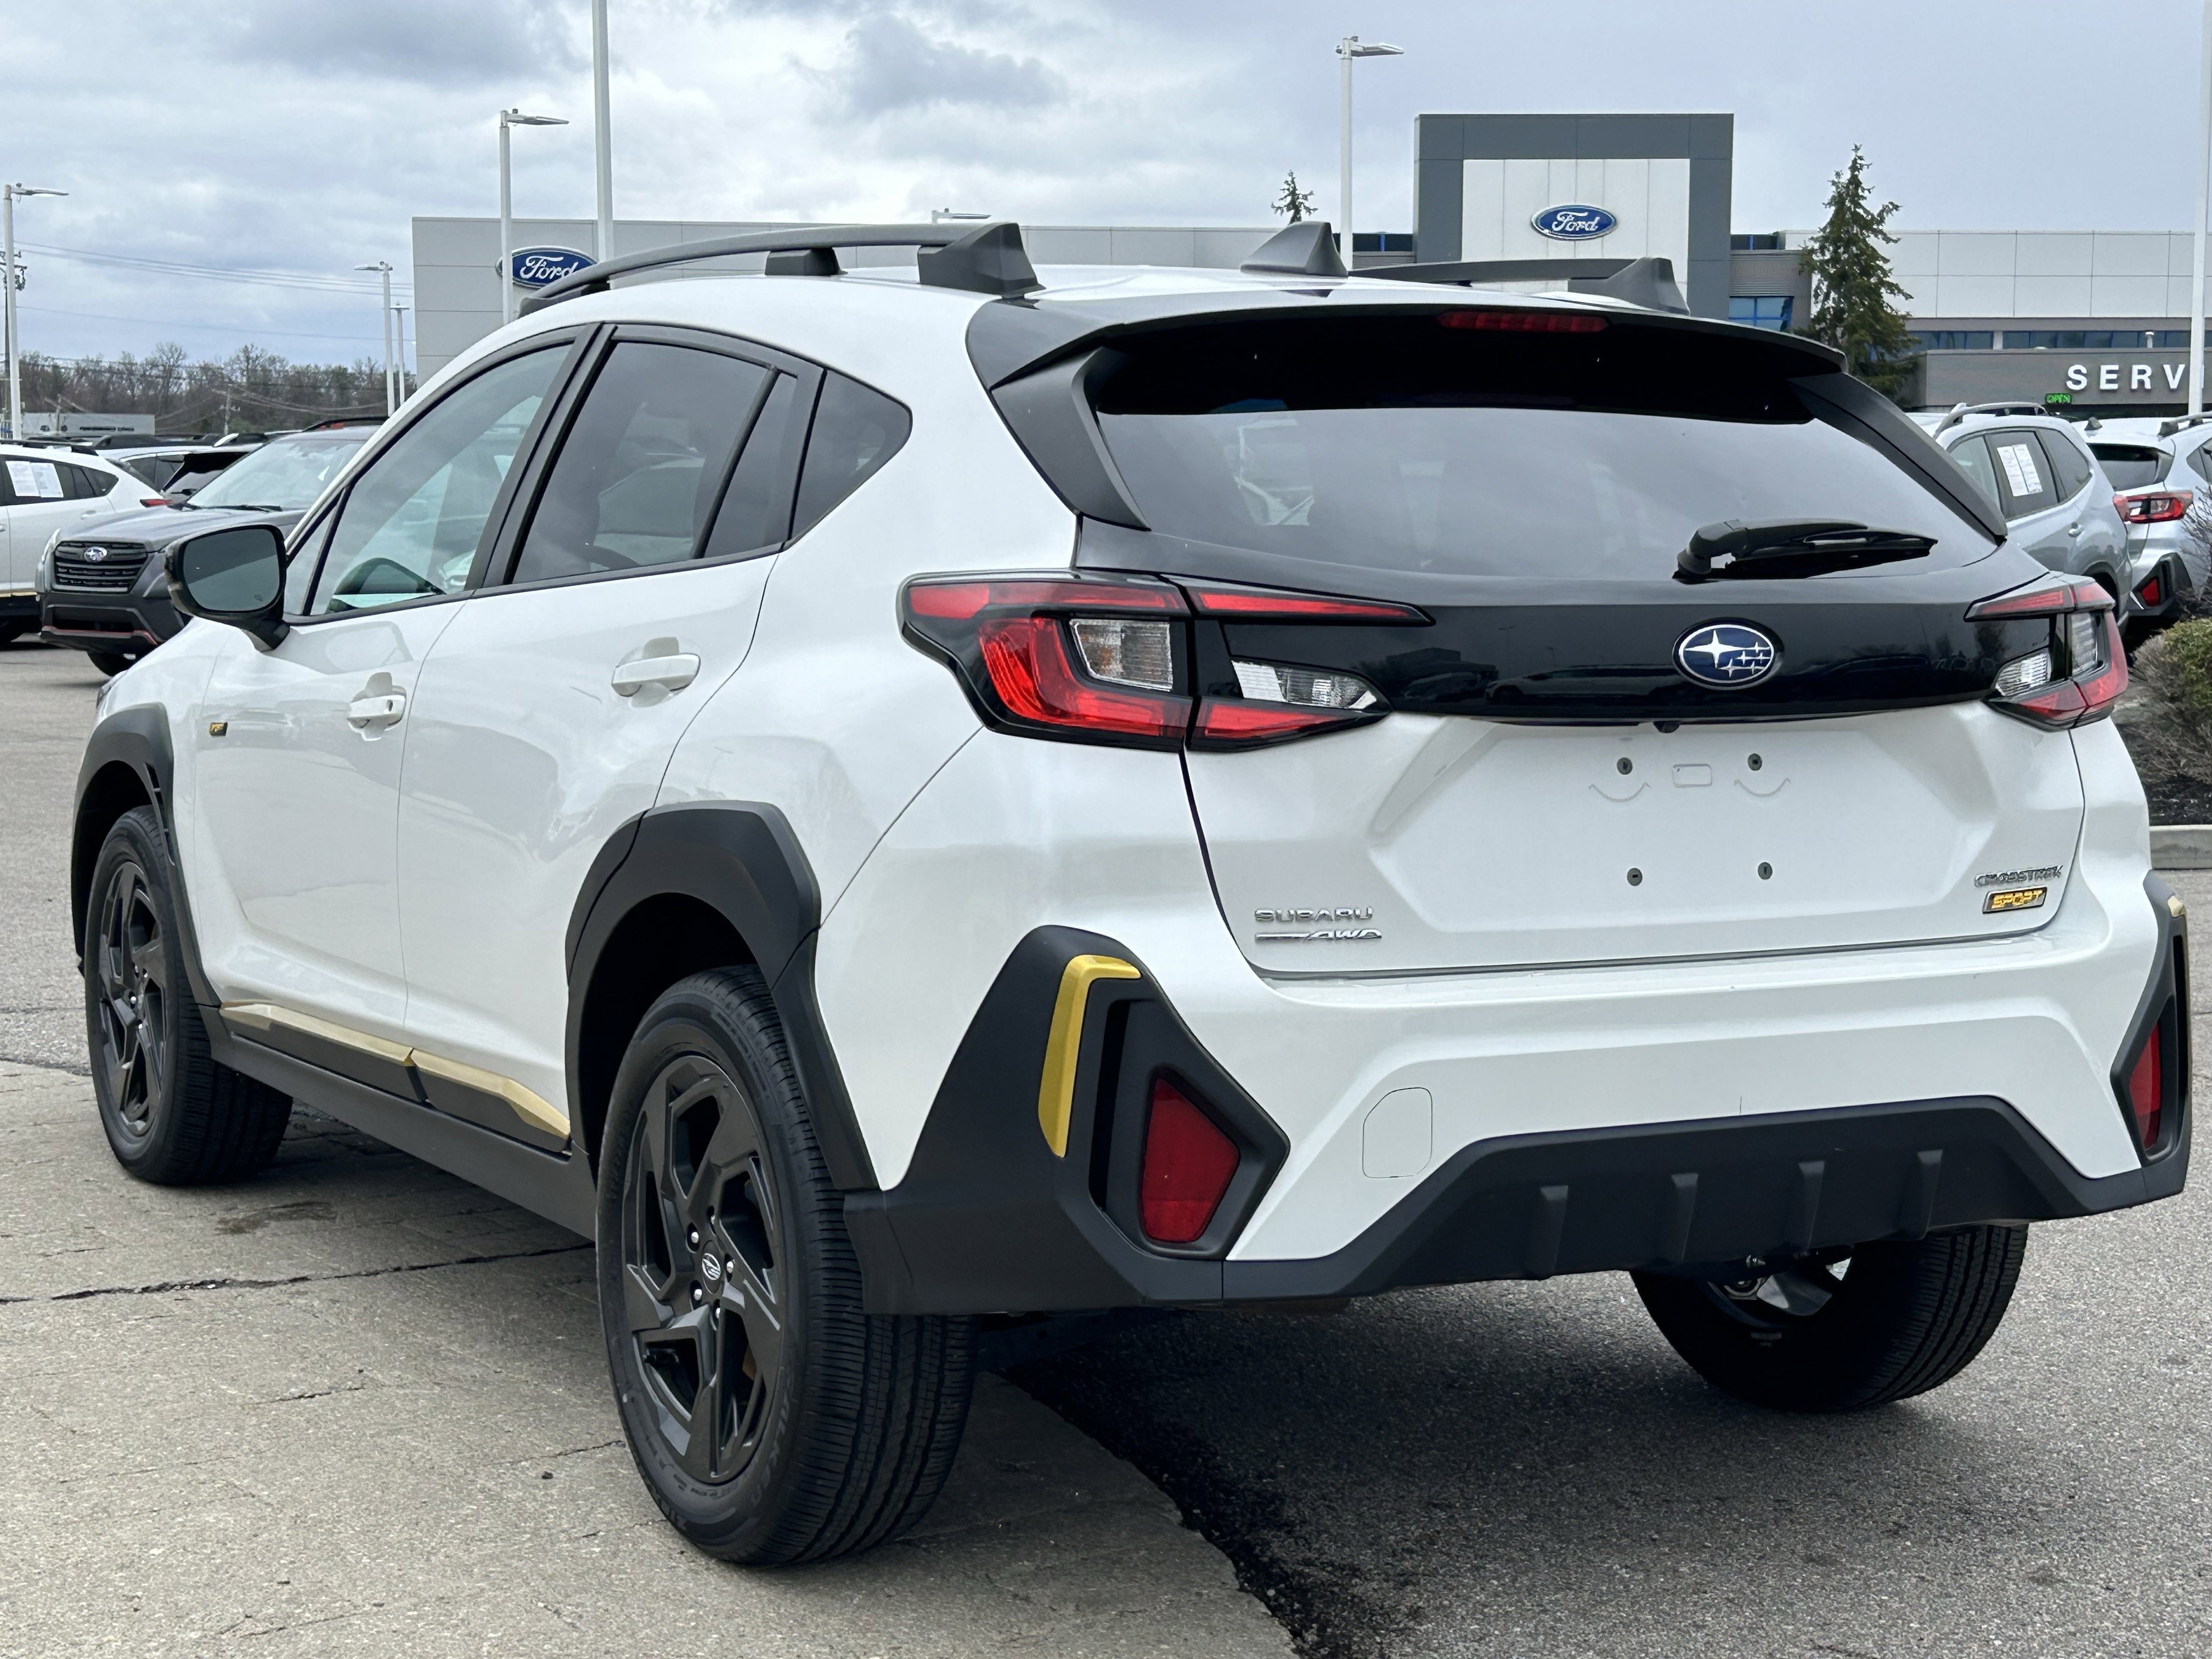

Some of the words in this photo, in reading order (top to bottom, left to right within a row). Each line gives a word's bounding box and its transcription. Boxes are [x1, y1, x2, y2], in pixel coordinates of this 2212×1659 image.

[1551, 211, 1600, 232] Ford
[520, 255, 579, 279] Ford
[2066, 364, 2204, 391] SERV
[1255, 906, 1374, 922] SUBARU
[1302, 928, 1383, 943] AWD
